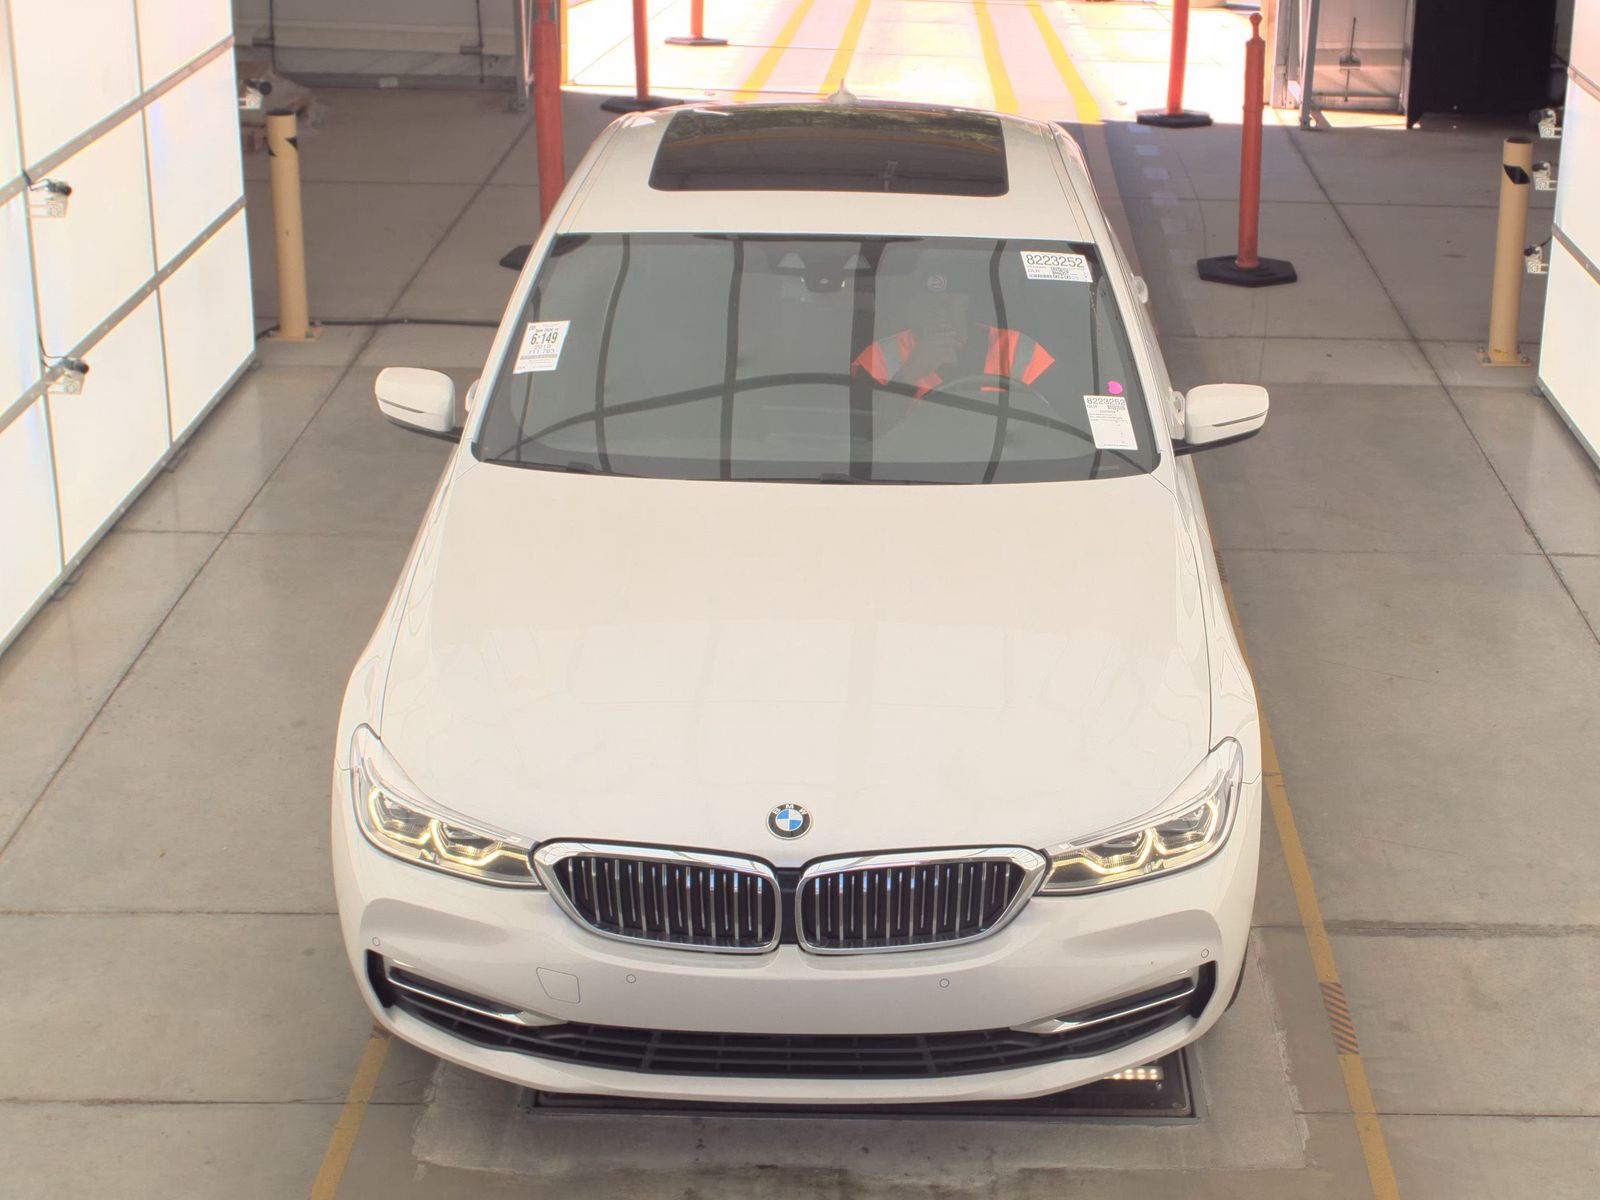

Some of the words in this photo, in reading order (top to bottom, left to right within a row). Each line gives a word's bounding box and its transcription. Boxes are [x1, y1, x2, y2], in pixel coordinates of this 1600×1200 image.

[1025, 254, 1084, 268] 8223252
[530, 331, 559, 346] 6:149
[1086, 397, 1126, 406] 8223252
[771, 803, 808, 815] BMW
